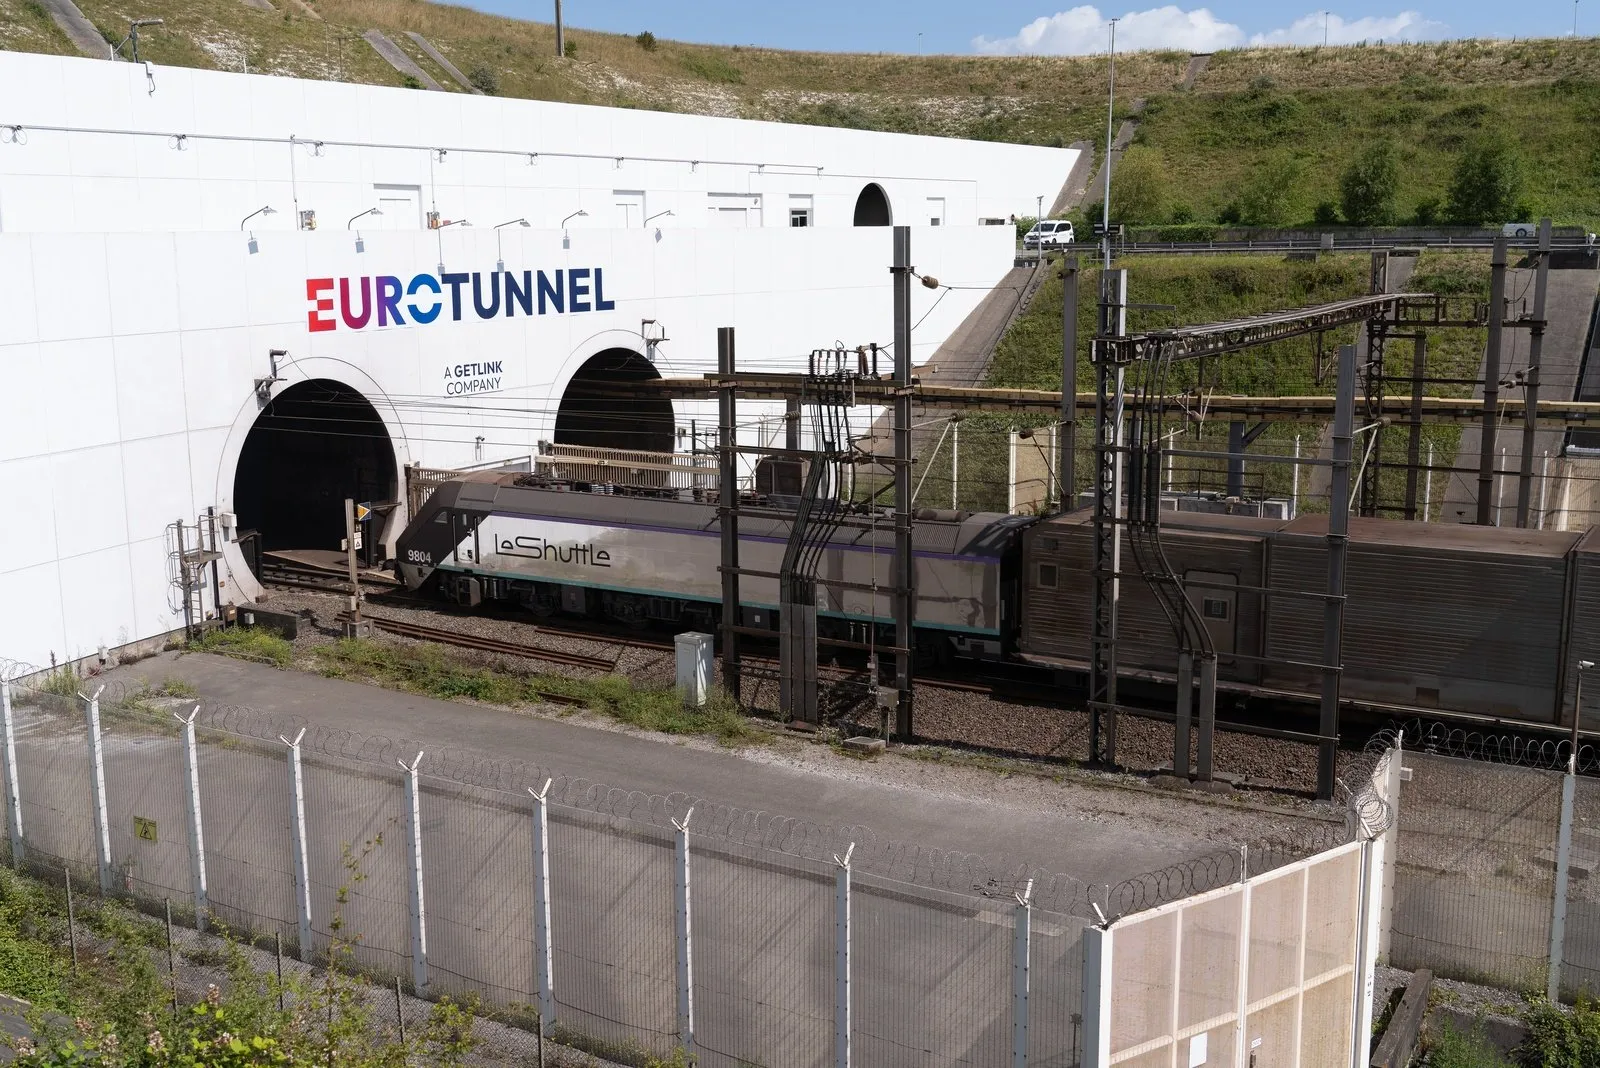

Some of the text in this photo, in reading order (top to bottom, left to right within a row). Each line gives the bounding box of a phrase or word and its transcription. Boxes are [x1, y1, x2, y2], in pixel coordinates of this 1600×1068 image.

[306, 267, 615, 332] EUROTUNNEL
[444, 360, 503, 379] A GETLINK
[446, 376, 501, 395] COMPANY
[408, 549, 431, 563] 9804
